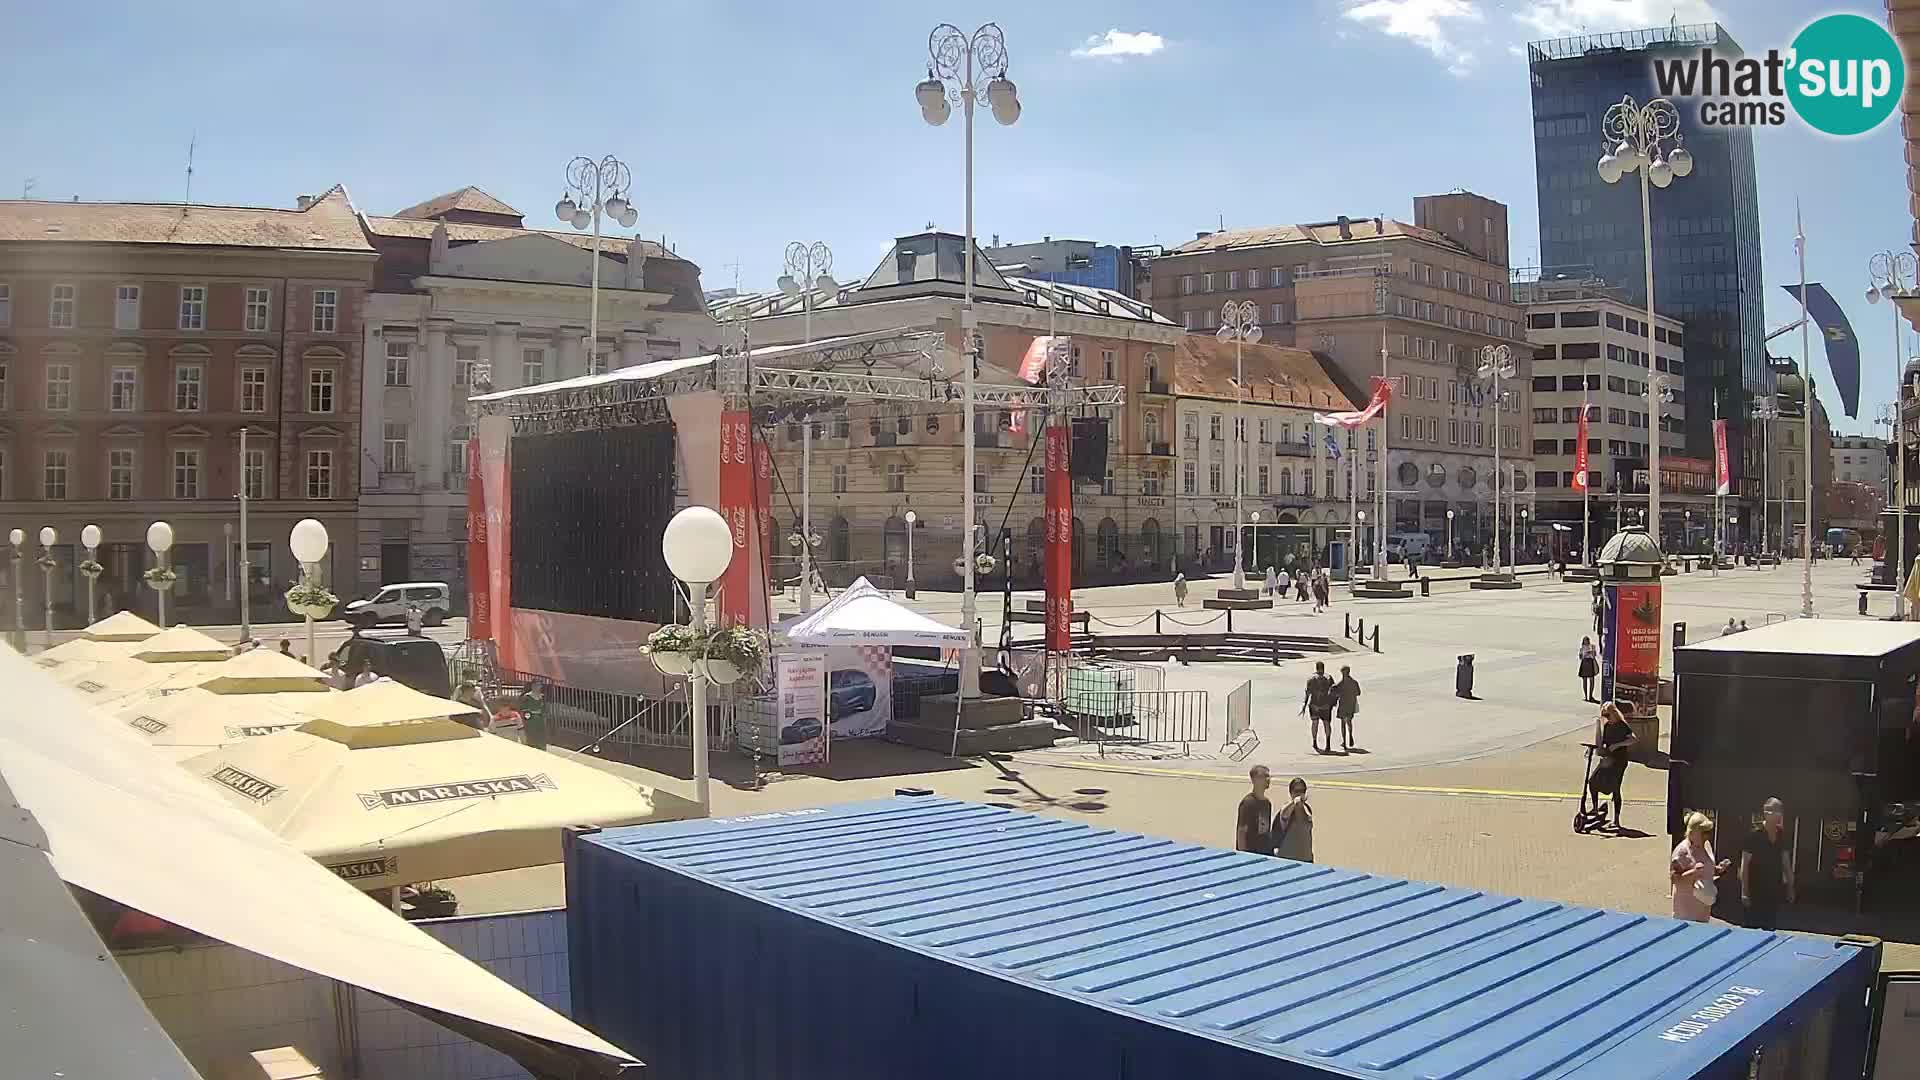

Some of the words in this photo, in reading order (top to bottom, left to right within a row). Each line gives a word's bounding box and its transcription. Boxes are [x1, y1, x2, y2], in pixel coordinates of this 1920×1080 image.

[735, 422, 747, 464] Coca-Cola
[960, 494, 997, 504] SGER
[734, 505, 746, 549] Coca-Cola
[1060, 506, 1069, 543] Coca-Cola
[1060, 596, 1069, 633] Coca-Cola
[391, 776, 527, 804] MARASKA
